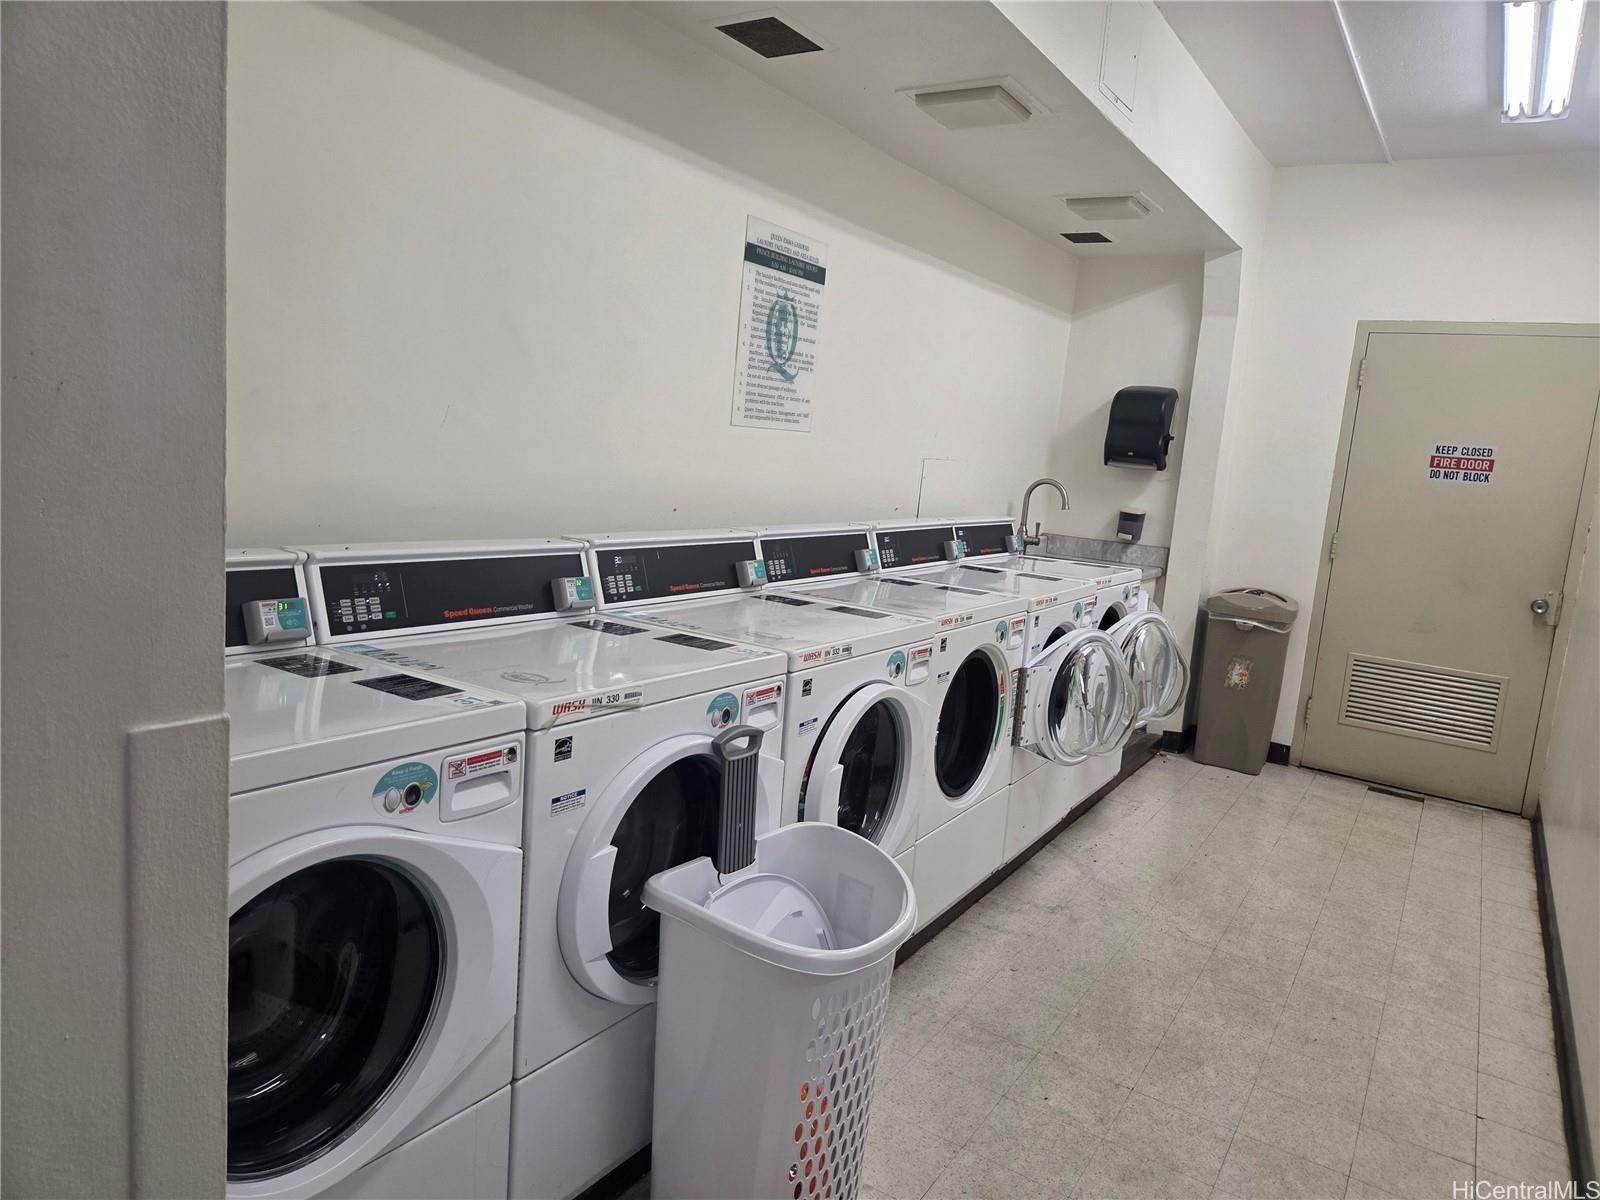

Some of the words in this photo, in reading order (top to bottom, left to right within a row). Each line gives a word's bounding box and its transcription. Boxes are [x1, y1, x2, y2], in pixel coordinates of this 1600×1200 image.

[1436, 445, 1458, 455] KEEP
[1461, 446, 1493, 457] CLOSED
[1433, 458, 1458, 468] FIRE
[1460, 460, 1490, 470] DOOR
[1430, 470, 1440, 479] DO
[1443, 470, 1460, 480] NOT
[1462, 472, 1490, 483] BLOCK
[444, 608, 468, 618] Speed
[804, 651, 822, 662] WASH
[552, 699, 586, 715] WASH
[606, 694, 620, 704] 330
